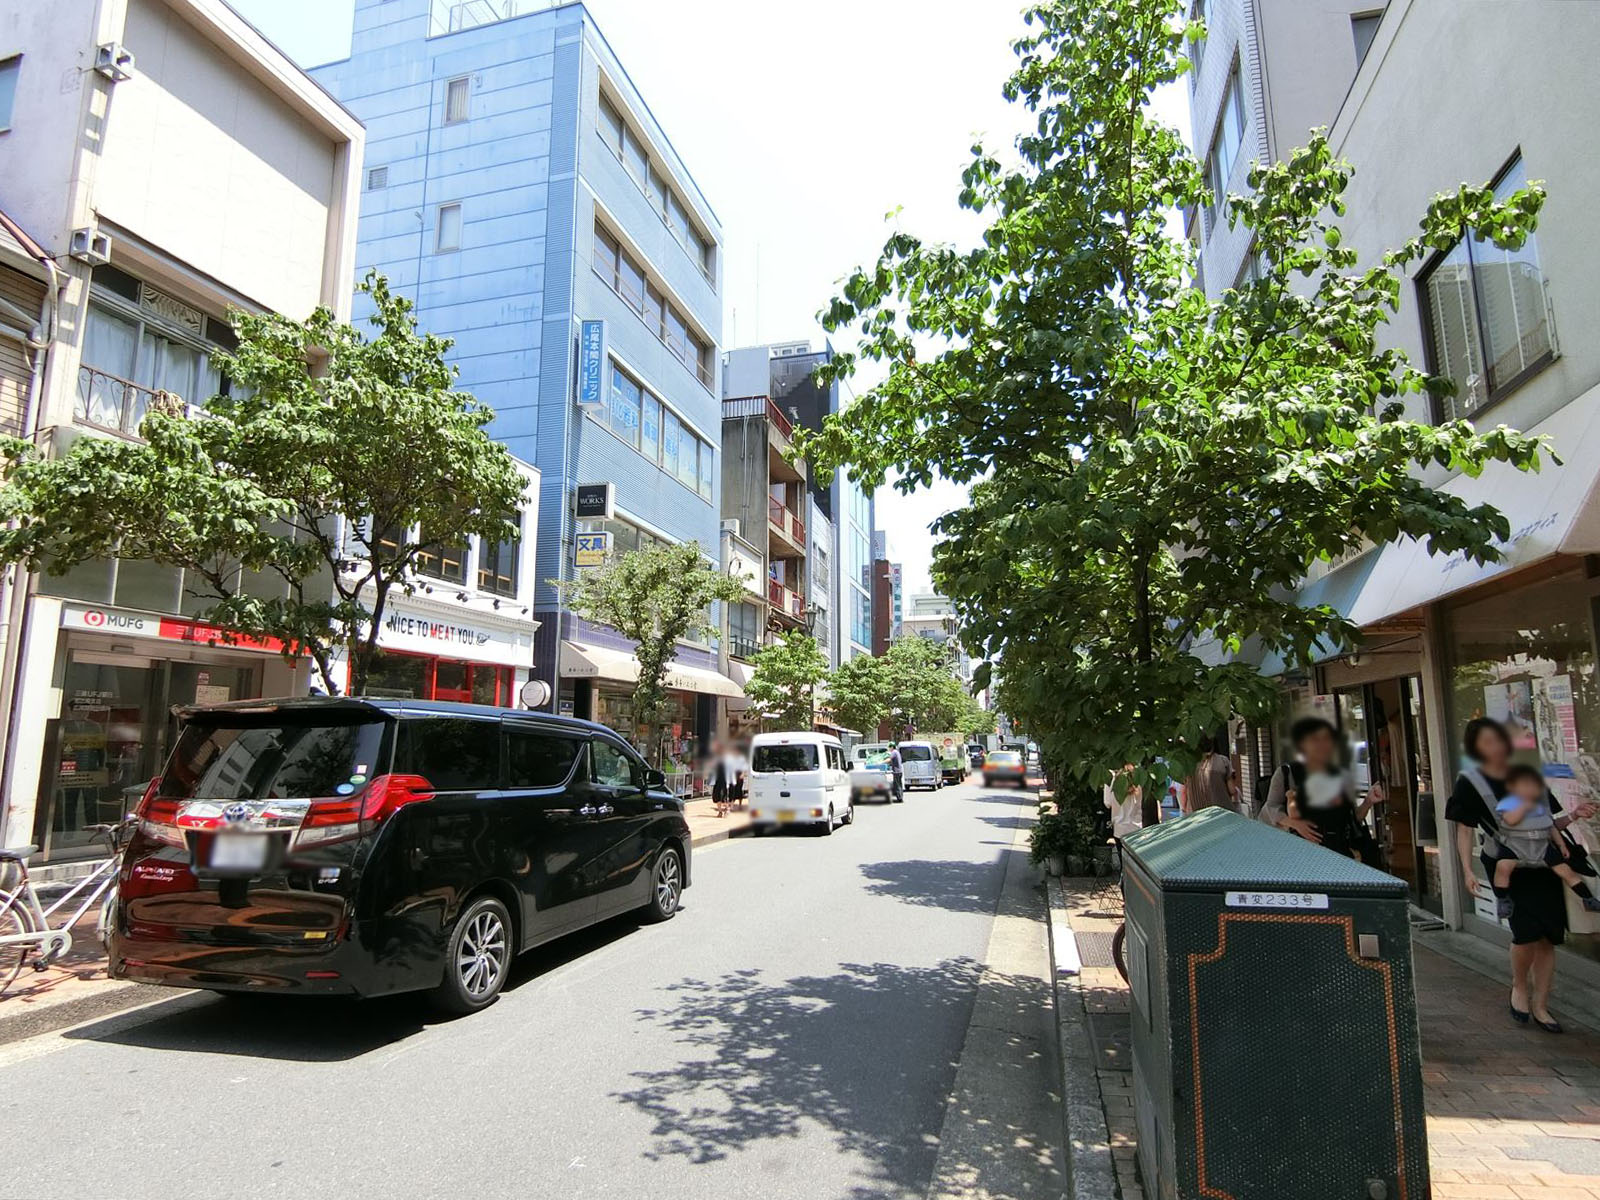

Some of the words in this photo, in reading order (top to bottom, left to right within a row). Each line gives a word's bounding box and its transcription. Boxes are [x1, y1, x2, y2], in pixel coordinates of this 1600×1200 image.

[580, 497, 605, 505] WORKS
[578, 537, 604, 552] 文具
[106, 614, 144, 630] MUFG
[391, 615, 414, 635] NICE
[418, 620, 429, 637] TO
[430, 624, 455, 641] MEAT
